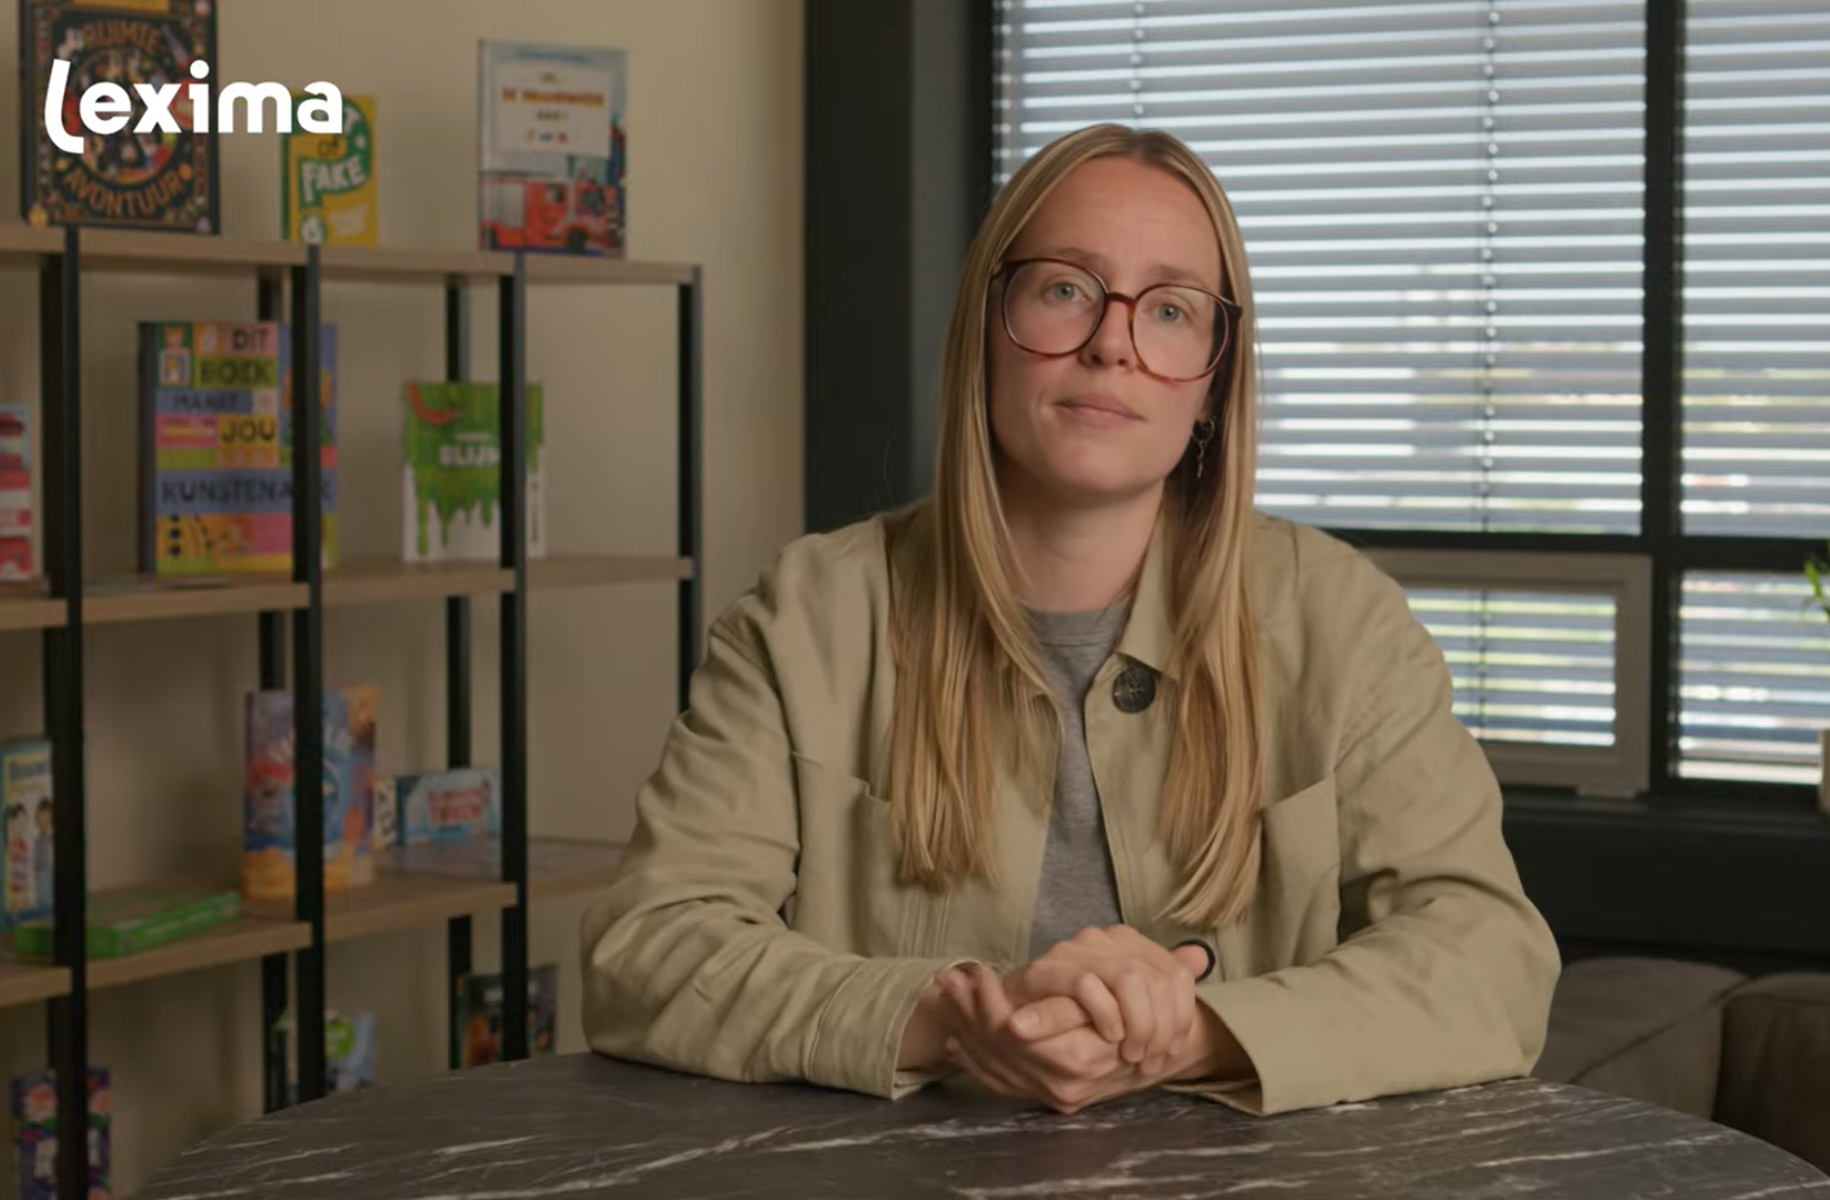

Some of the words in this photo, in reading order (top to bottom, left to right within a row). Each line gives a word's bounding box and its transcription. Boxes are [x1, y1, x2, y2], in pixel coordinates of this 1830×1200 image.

[301, 155, 367, 203] FAKE
[63, 168, 184, 217] AVONTUUR
[233, 328, 269, 350] DIT
[201, 360, 272, 384] BOEK
[220, 420, 275, 443] JOU
